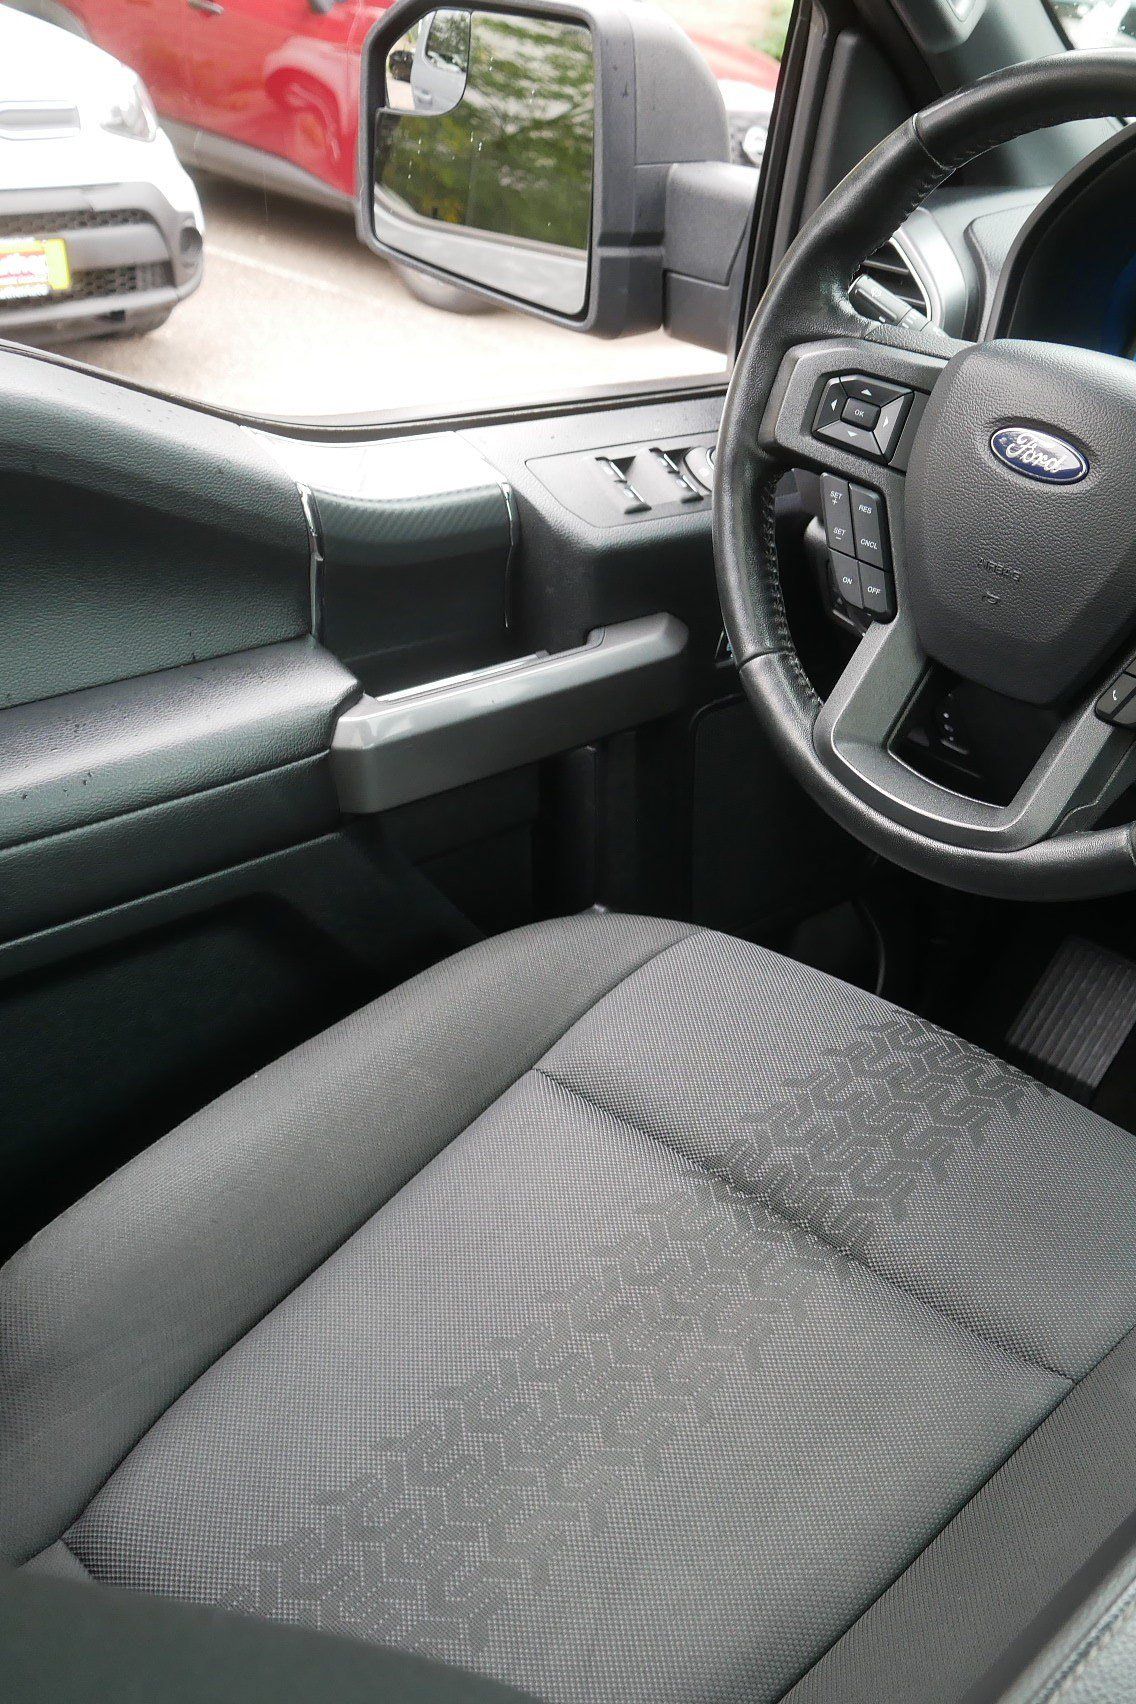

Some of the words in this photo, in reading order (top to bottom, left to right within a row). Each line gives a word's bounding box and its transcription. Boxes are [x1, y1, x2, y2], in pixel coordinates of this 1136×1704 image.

[854, 408, 864, 418] OK
[1005, 432, 1067, 473] Ford
[830, 490, 843, 500] SET
[858, 504, 872, 514] RES
[833, 527, 846, 536] SET
[860, 538, 878, 550] CNCL
[842, 576, 853, 585] ON
[867, 586, 881, 595] OFF
